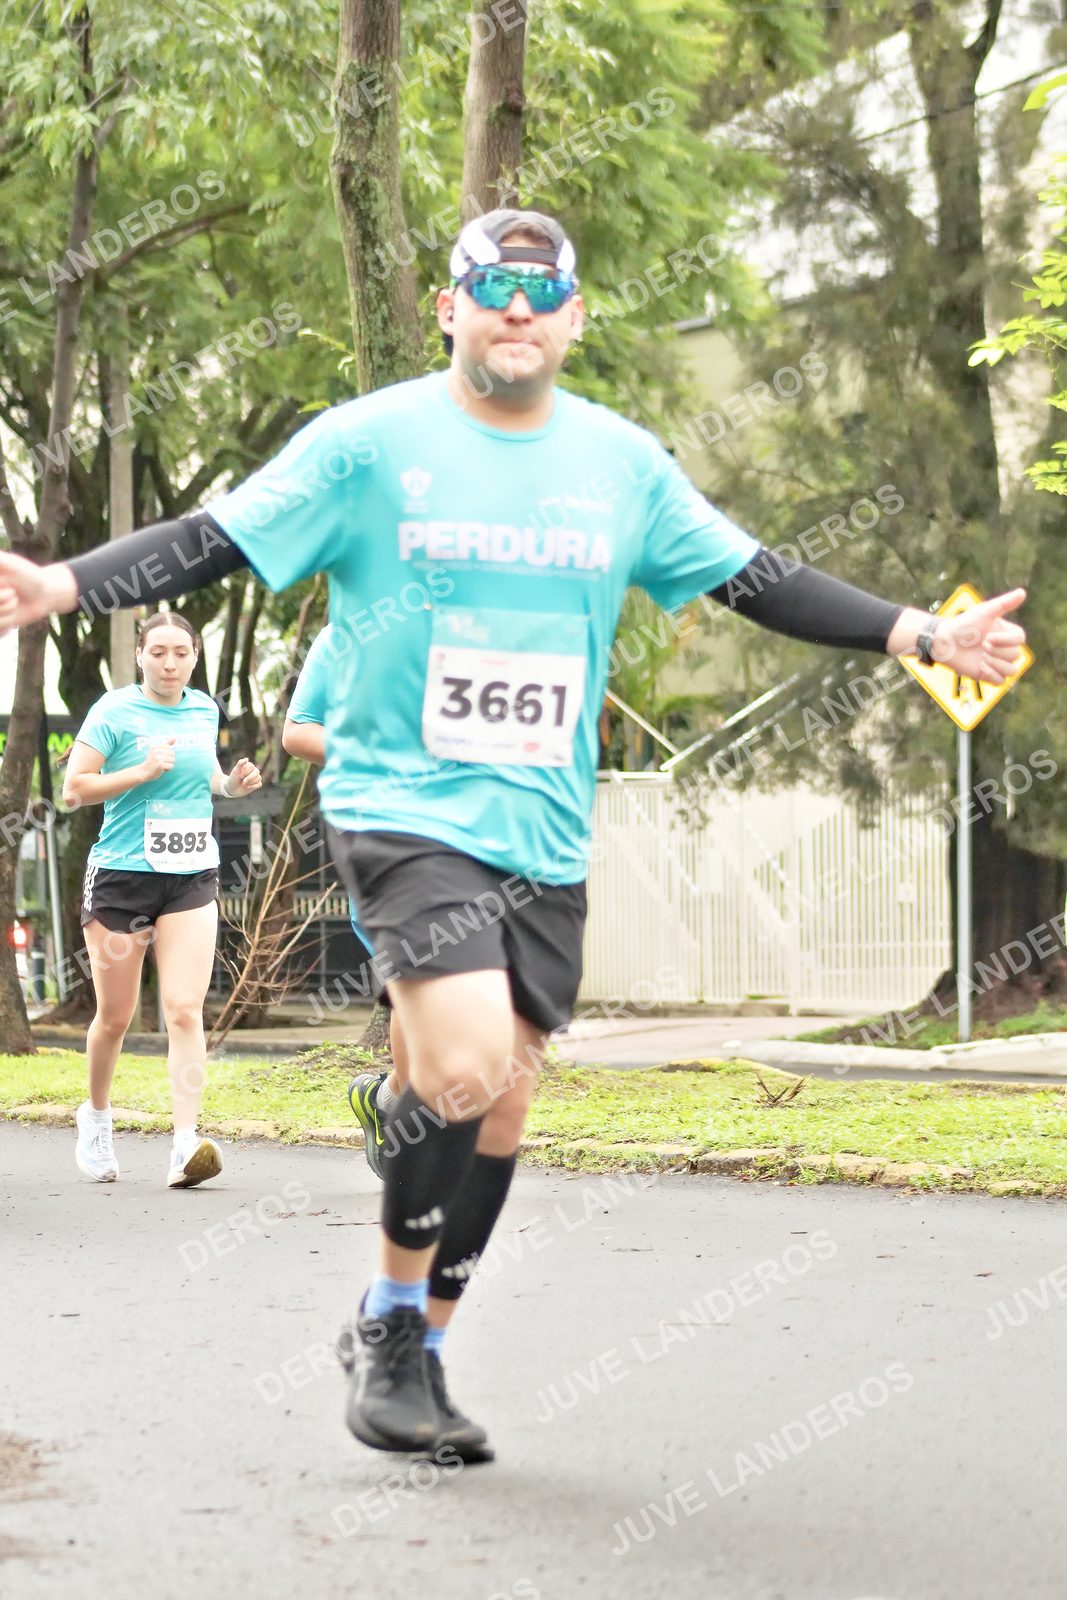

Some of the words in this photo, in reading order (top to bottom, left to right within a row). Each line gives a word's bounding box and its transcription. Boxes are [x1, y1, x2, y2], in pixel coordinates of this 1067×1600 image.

[398, 520, 612, 573] PERDURA
[438, 676, 567, 728] 3661
[150, 832, 208, 854] 3893
